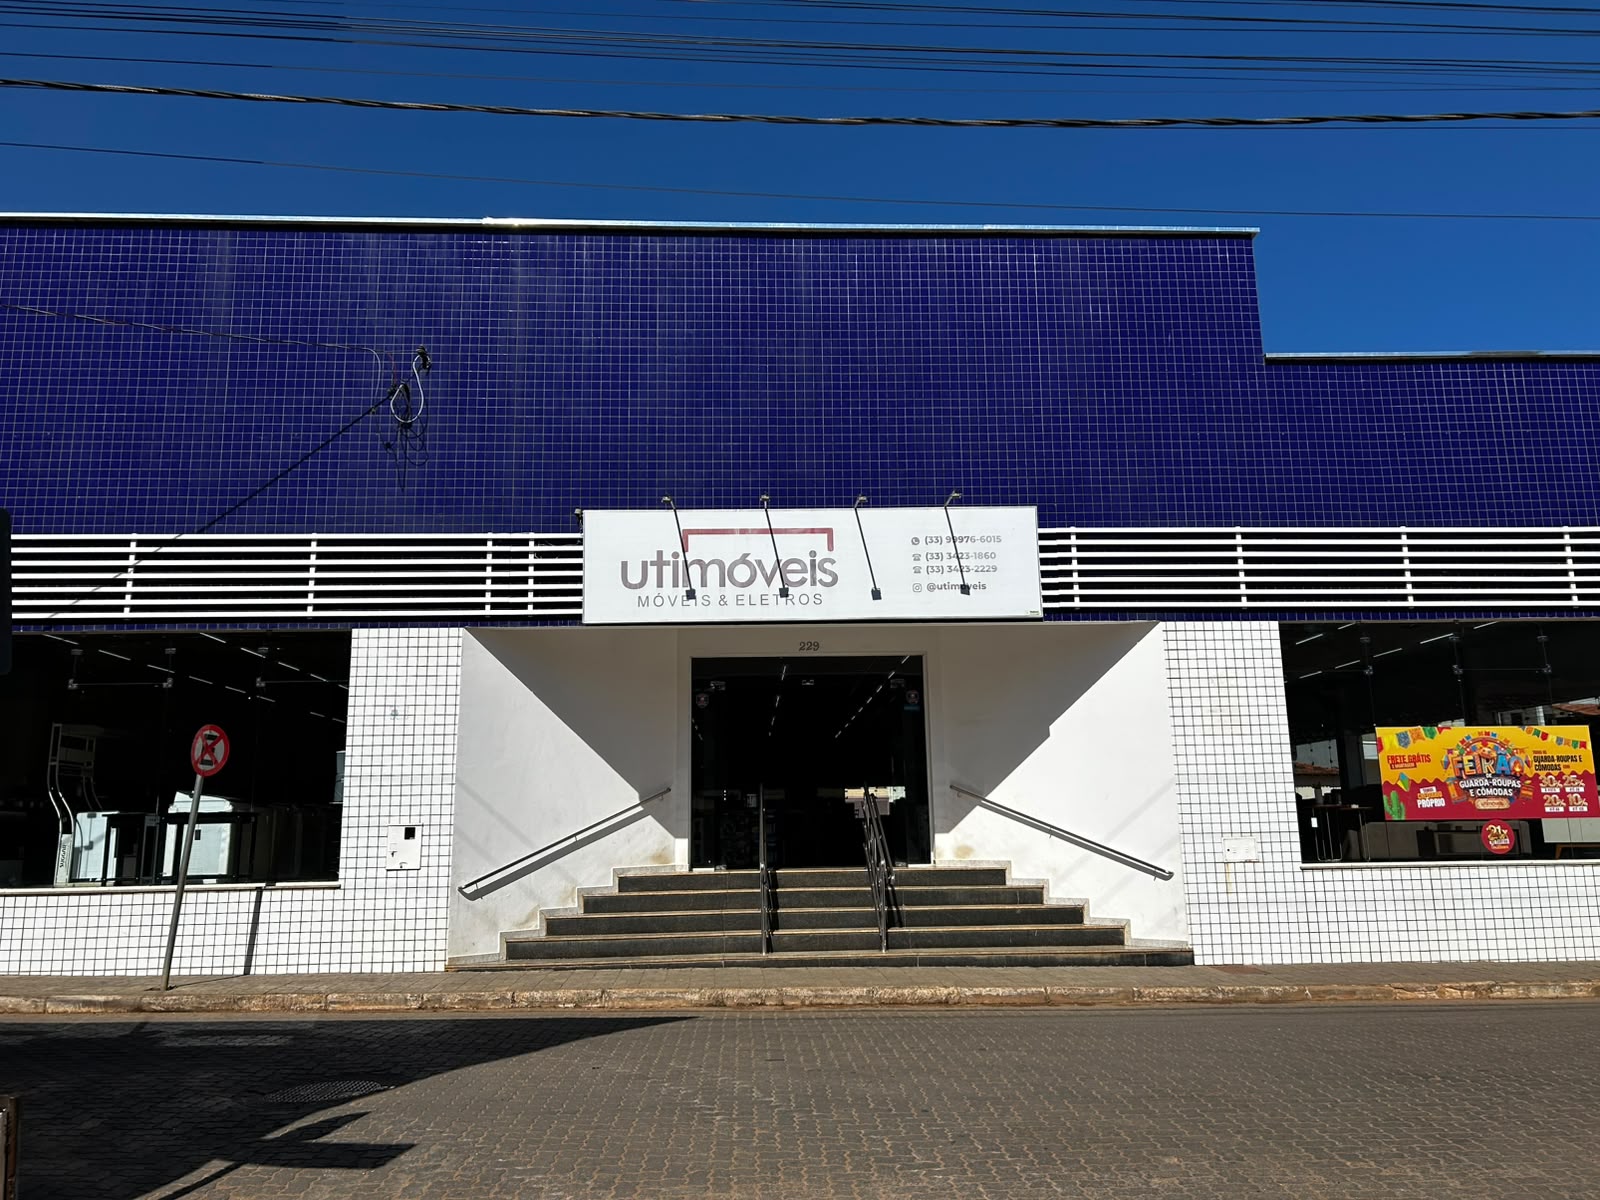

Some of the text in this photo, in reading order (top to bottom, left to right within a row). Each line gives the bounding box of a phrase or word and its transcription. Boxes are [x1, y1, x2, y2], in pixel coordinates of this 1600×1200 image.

[925, 535, 1002, 546] (33) 99976-6015
[925, 552, 997, 562] (33) 3423-1860
[620, 549, 839, 590] utimóveis
[926, 565, 998, 575] (33) 3423-2229
[718, 594, 728, 606] &
[735, 593, 823, 606] ELETROS
[798, 640, 820, 652] 229
[1387, 752, 1432, 765] FRETE GRÁTIS
[1533, 755, 1578, 764] GUARDA-ROUPAS
[1459, 778, 1522, 788] GUARDA-ROUPAS
[1469, 787, 1514, 797] E CÔMODAS
[1416, 797, 1446, 809] PRÓPRIO
